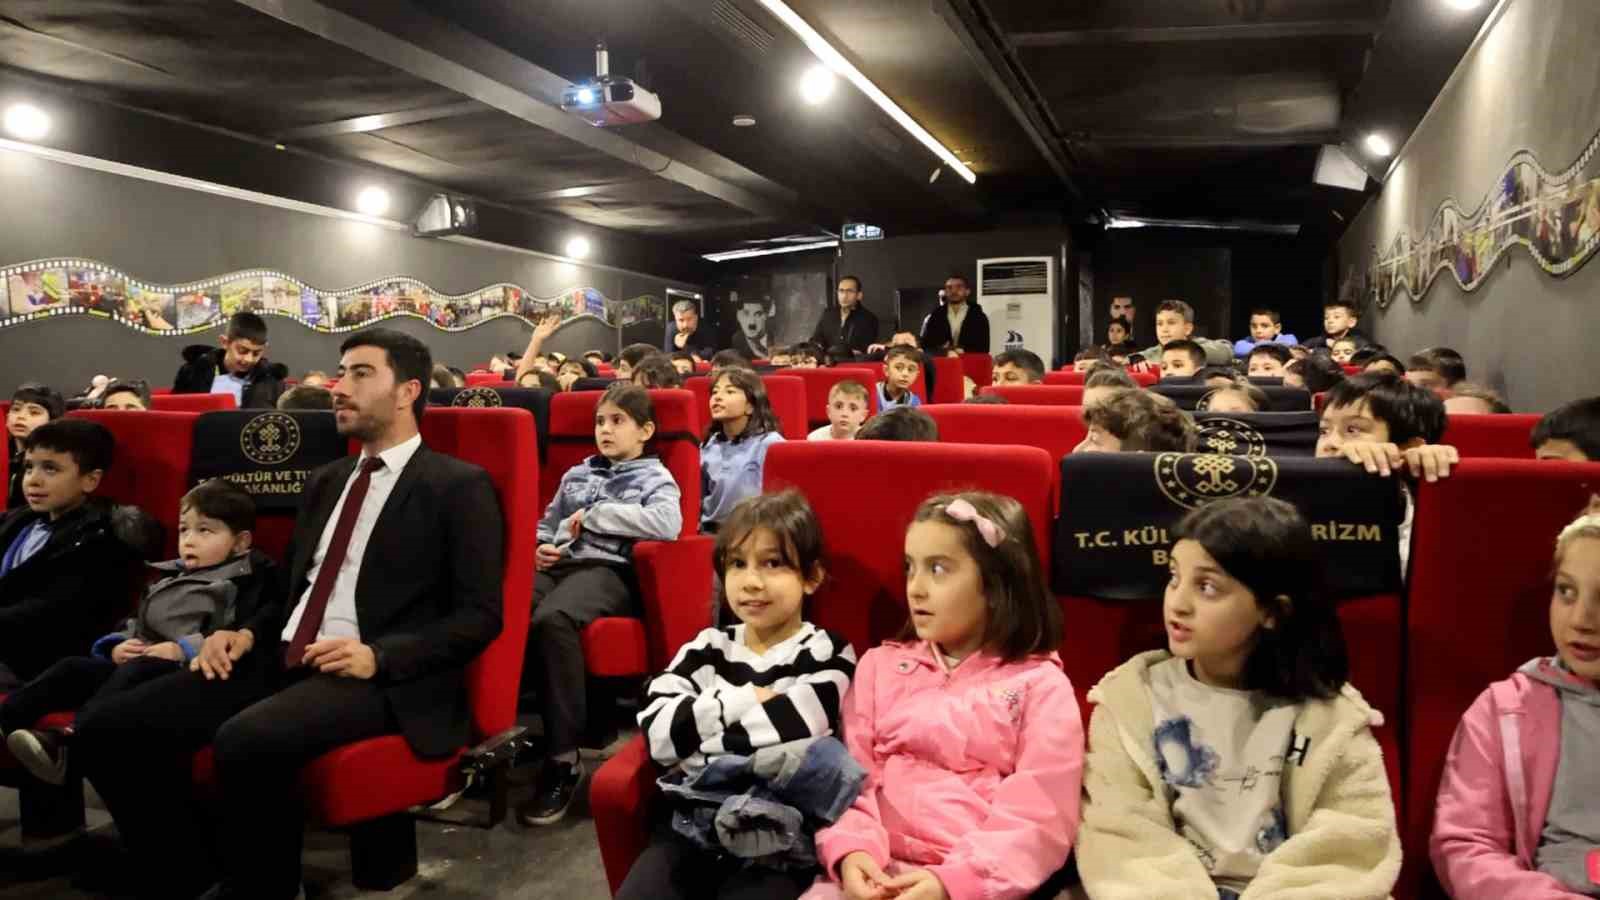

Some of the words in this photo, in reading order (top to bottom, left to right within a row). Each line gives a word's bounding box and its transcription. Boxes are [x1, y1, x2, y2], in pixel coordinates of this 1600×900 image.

[275, 471, 291, 481] VE
[245, 482, 305, 494] KANLIĞ
[1074, 531, 1118, 548] T.C.
[1123, 526, 1169, 545] KÜL
[1311, 520, 1381, 541] RİZM
